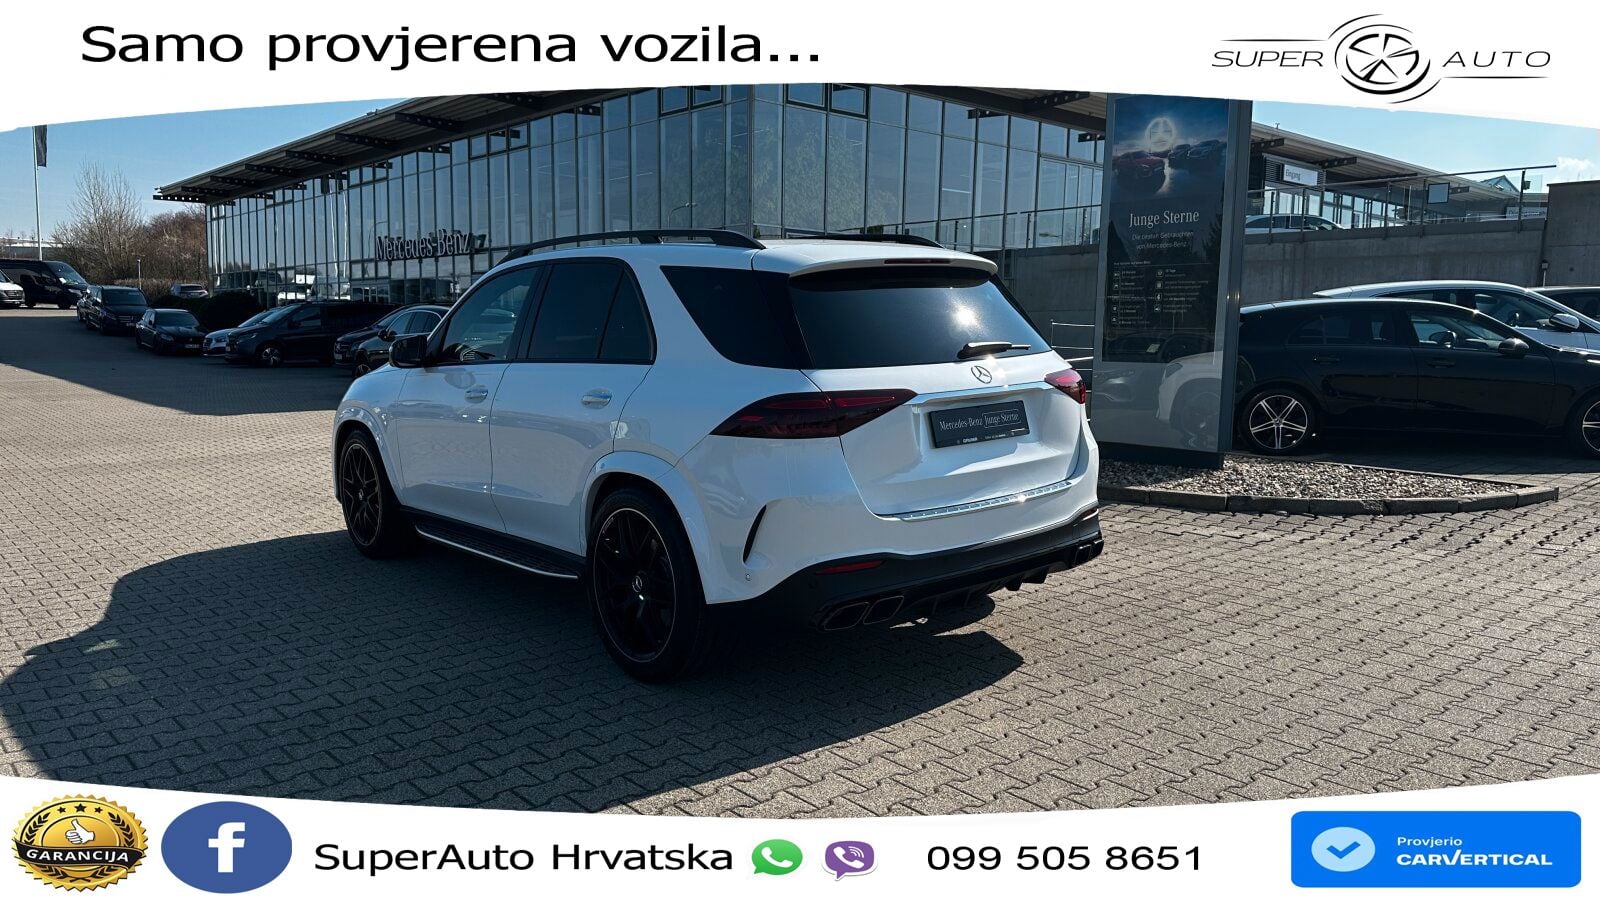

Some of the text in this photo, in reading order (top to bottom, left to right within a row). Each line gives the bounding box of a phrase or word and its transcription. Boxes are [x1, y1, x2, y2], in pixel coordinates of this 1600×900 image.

[1129, 210, 1200, 229] Junge Sterne
[375, 230, 471, 261] Mercedes-Benz
[939, 411, 1019, 432] Mercedes-Benz Junge Sterne
